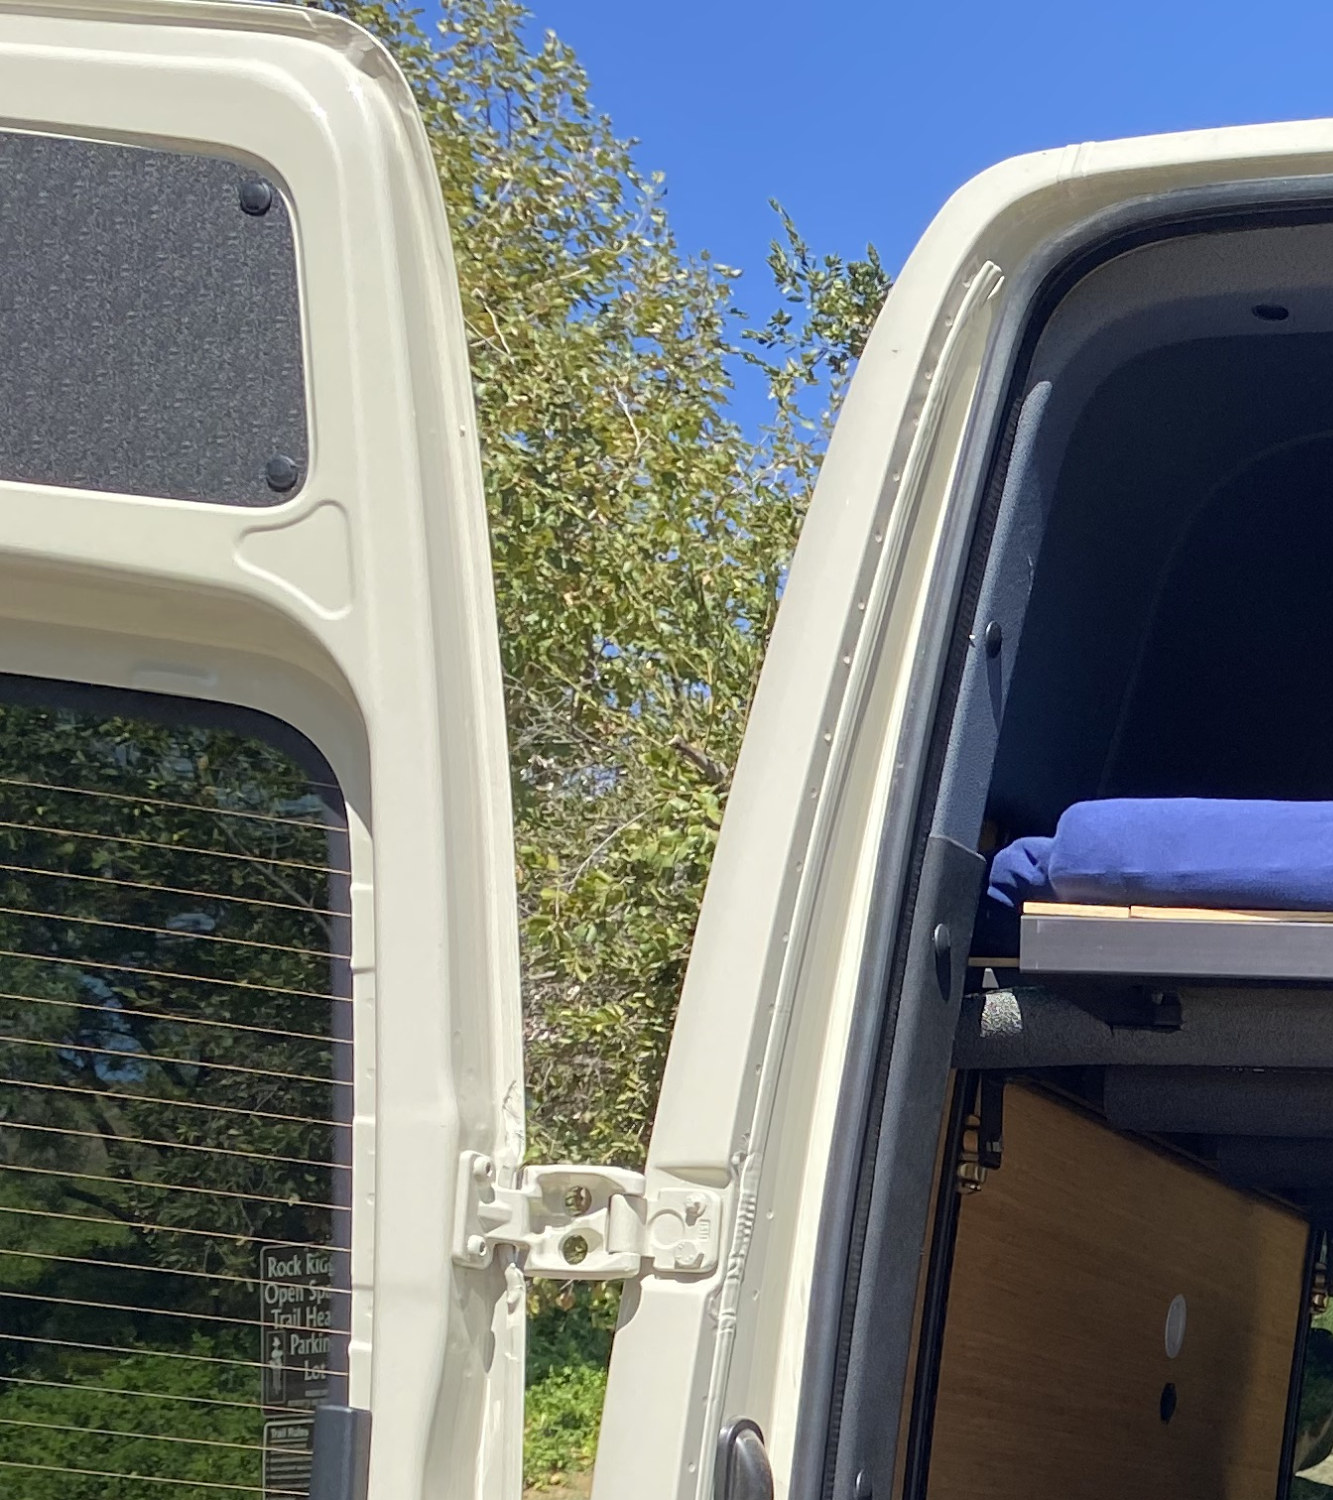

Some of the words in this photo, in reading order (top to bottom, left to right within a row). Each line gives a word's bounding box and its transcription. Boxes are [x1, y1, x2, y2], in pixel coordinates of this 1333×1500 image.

[268, 1254, 302, 1278] Rock
[265, 1283, 304, 1307] Open
[309, 1280, 331, 1304] Spa
[271, 1306, 301, 1329] Trail
[306, 1306, 331, 1328] Hea
[290, 1332, 330, 1355] Parkin
[304, 1360, 326, 1381] Lot
